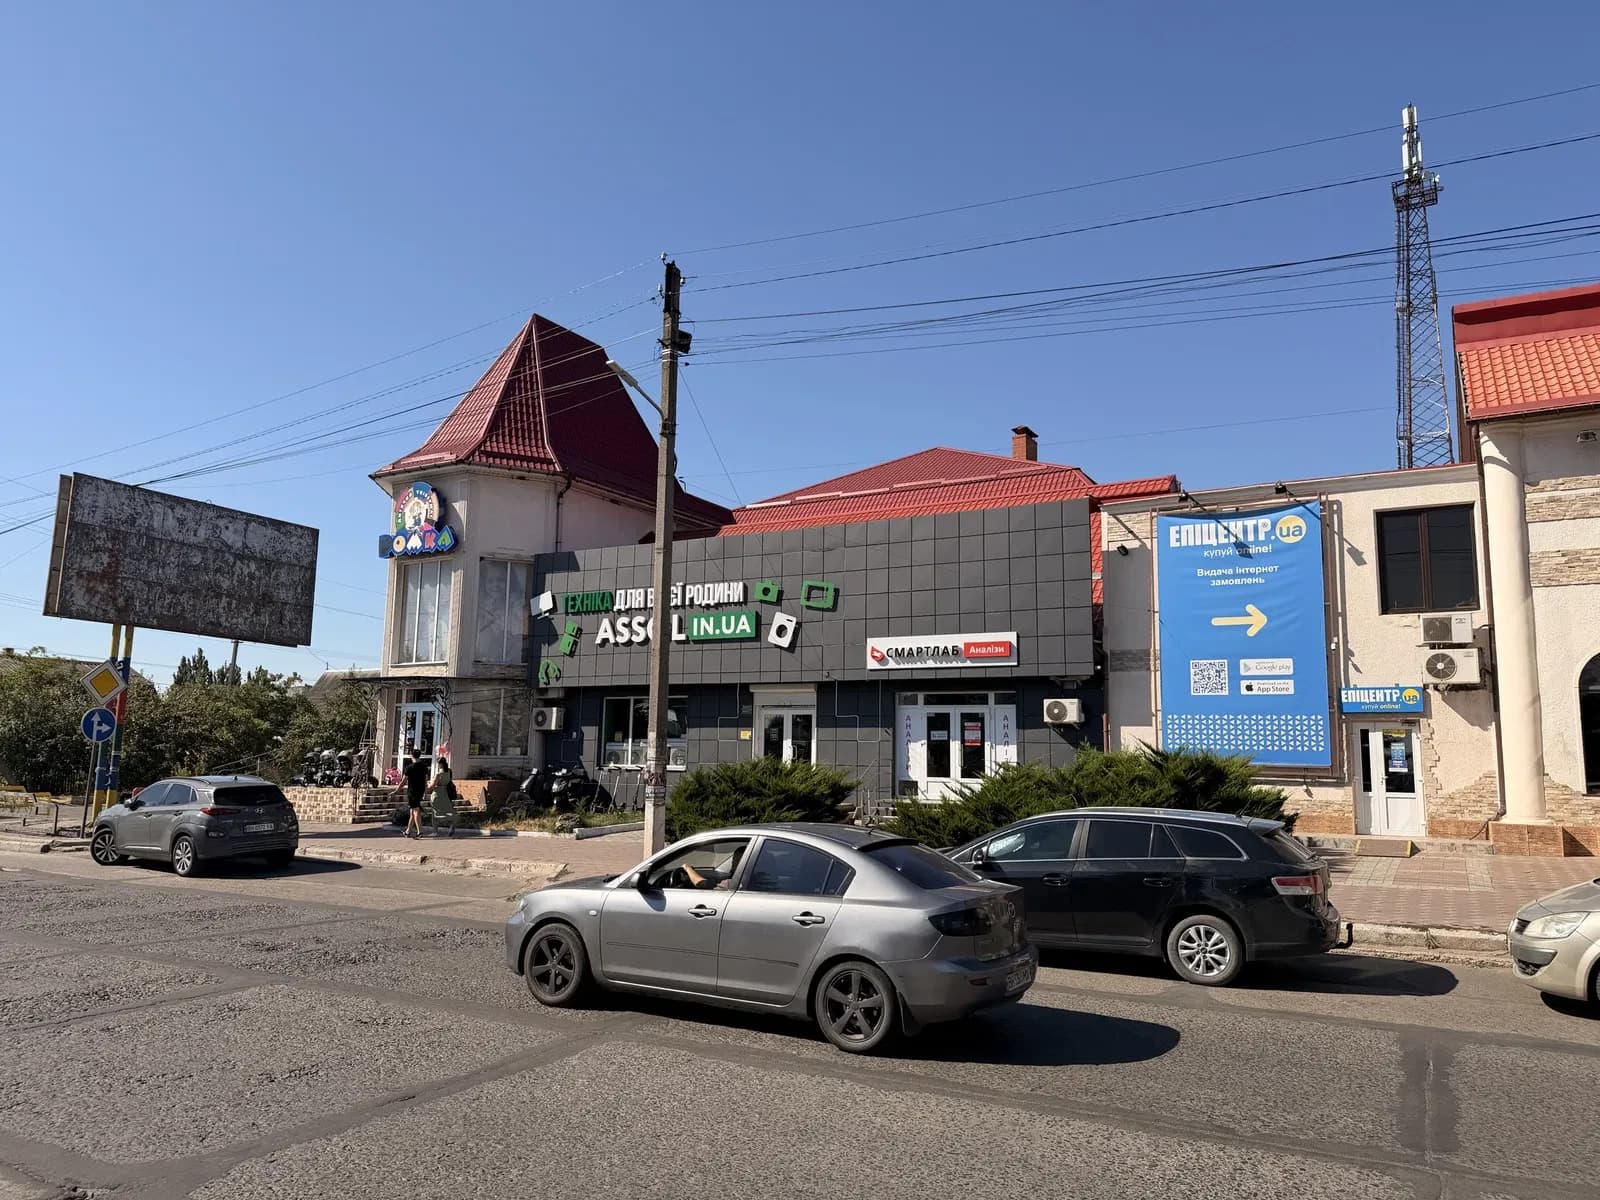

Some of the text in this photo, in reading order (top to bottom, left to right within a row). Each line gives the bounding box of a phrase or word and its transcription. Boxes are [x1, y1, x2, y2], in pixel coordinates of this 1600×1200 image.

[379, 527, 455, 558] ОМКА
[1204, 547, 1233, 558] купуй
[1197, 565, 1279, 577] Видача інтернет
[1210, 578, 1265, 586] замовлень
[562, 592, 612, 613] ТЕХНІКА
[613, 588, 646, 611] ДЛЯ
[686, 582, 744, 606] РОДИНИ
[693, 615, 751, 636] IN.UA
[886, 645, 1005, 657] СМАРТЛАБ Аналізи
